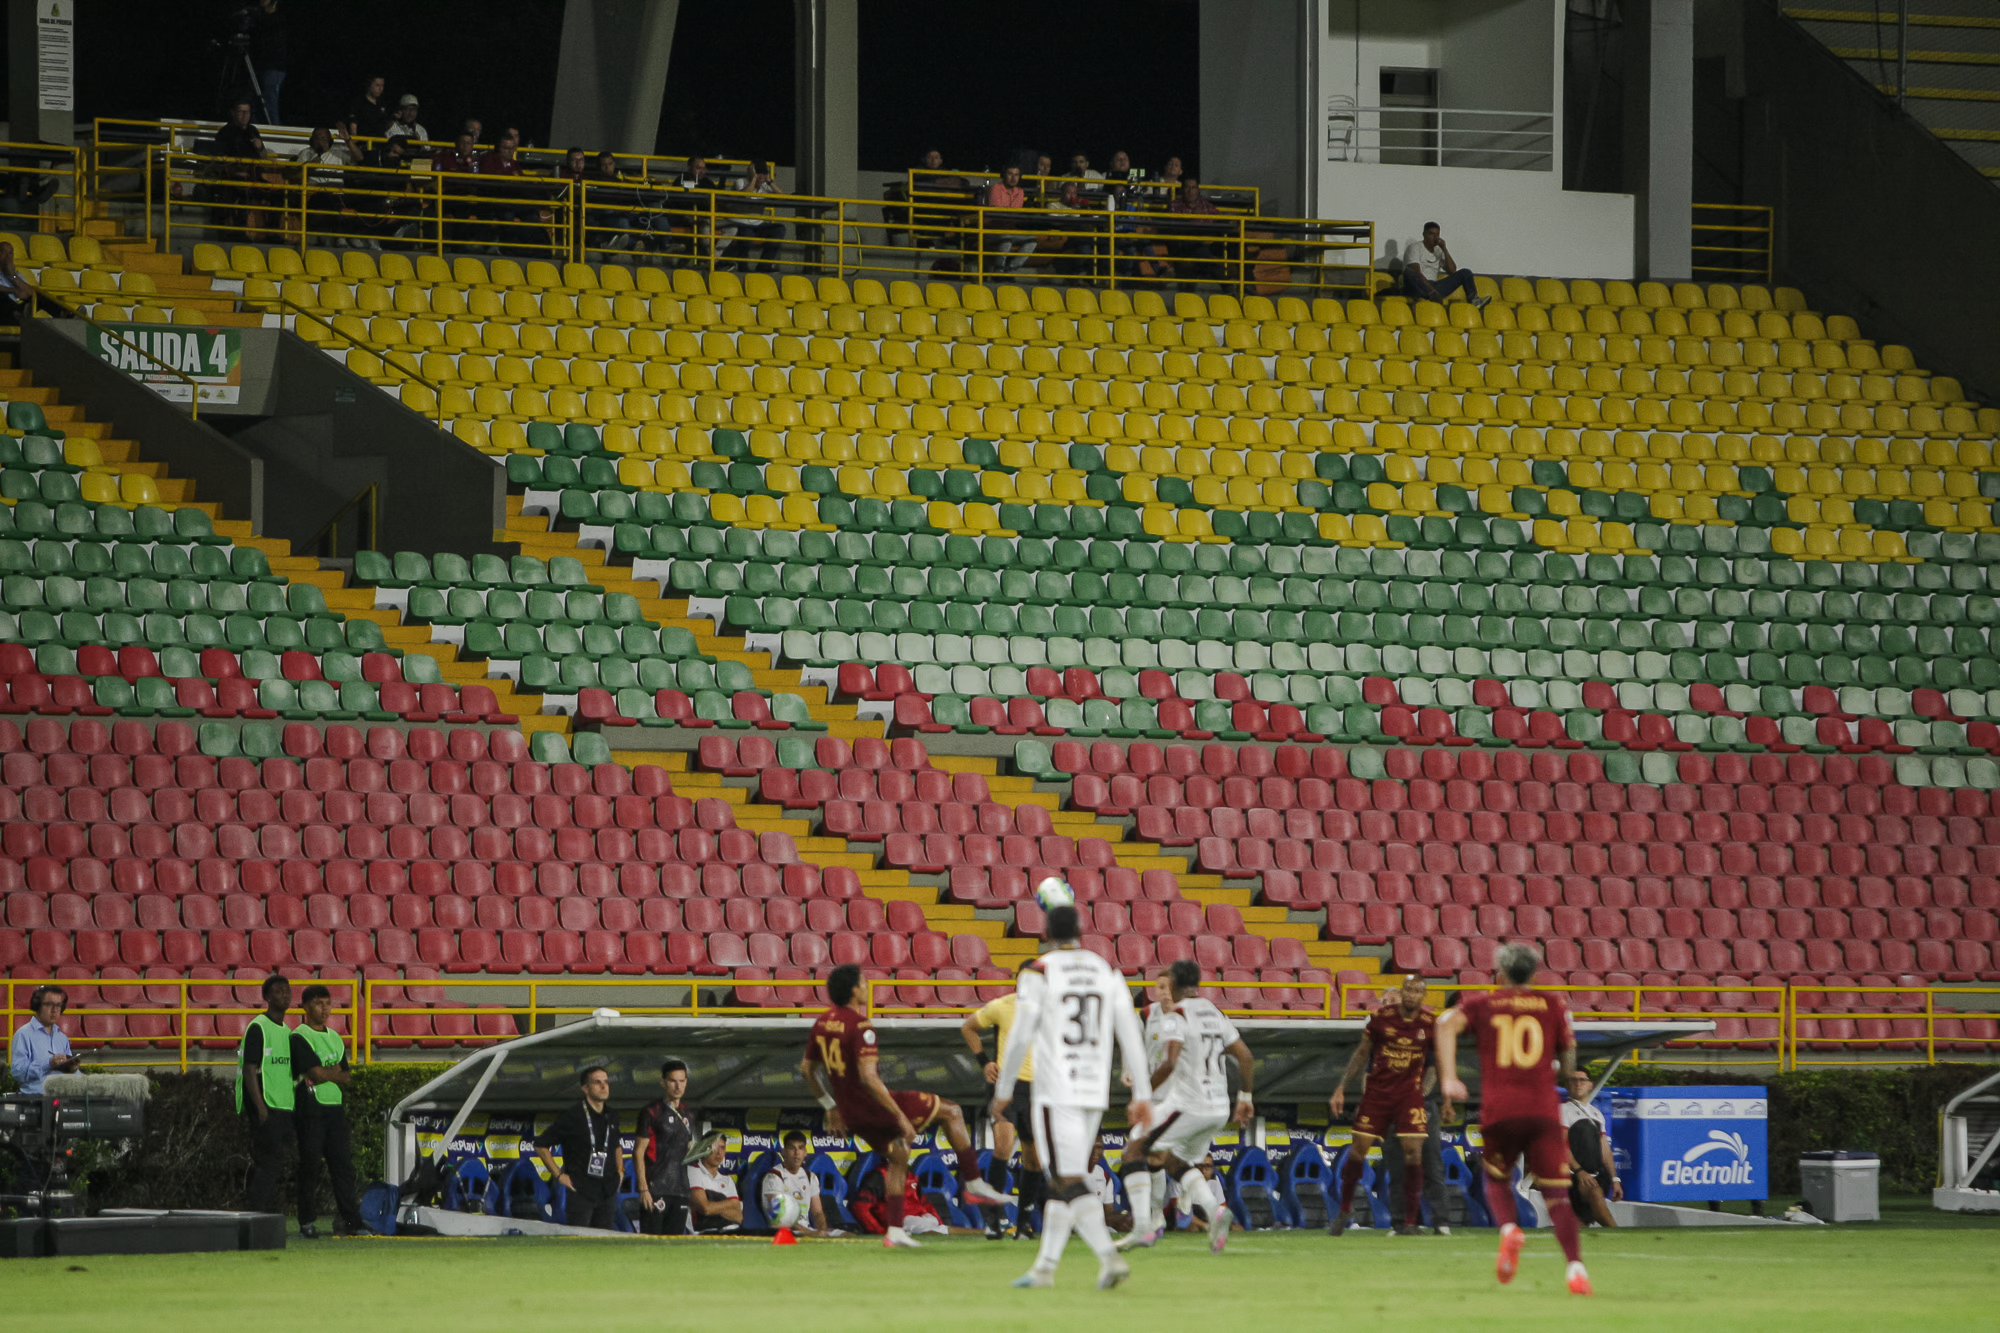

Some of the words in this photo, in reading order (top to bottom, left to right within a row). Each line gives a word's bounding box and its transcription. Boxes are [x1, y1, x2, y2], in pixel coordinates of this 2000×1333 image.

[100, 330, 201, 372] SALIDA
[209, 334, 228, 374] 4
[1490, 1013, 1544, 1069] 10
[816, 1035, 846, 1077] 14
[409, 1115, 443, 1130] BetPay
[489, 1118, 522, 1132] BetPlay
[742, 1135, 771, 1149] BetPlay
[812, 1135, 845, 1149] BetPlay
[1102, 1133, 1125, 1146] tPlay
[1661, 1159, 1753, 1185] Electrolit
